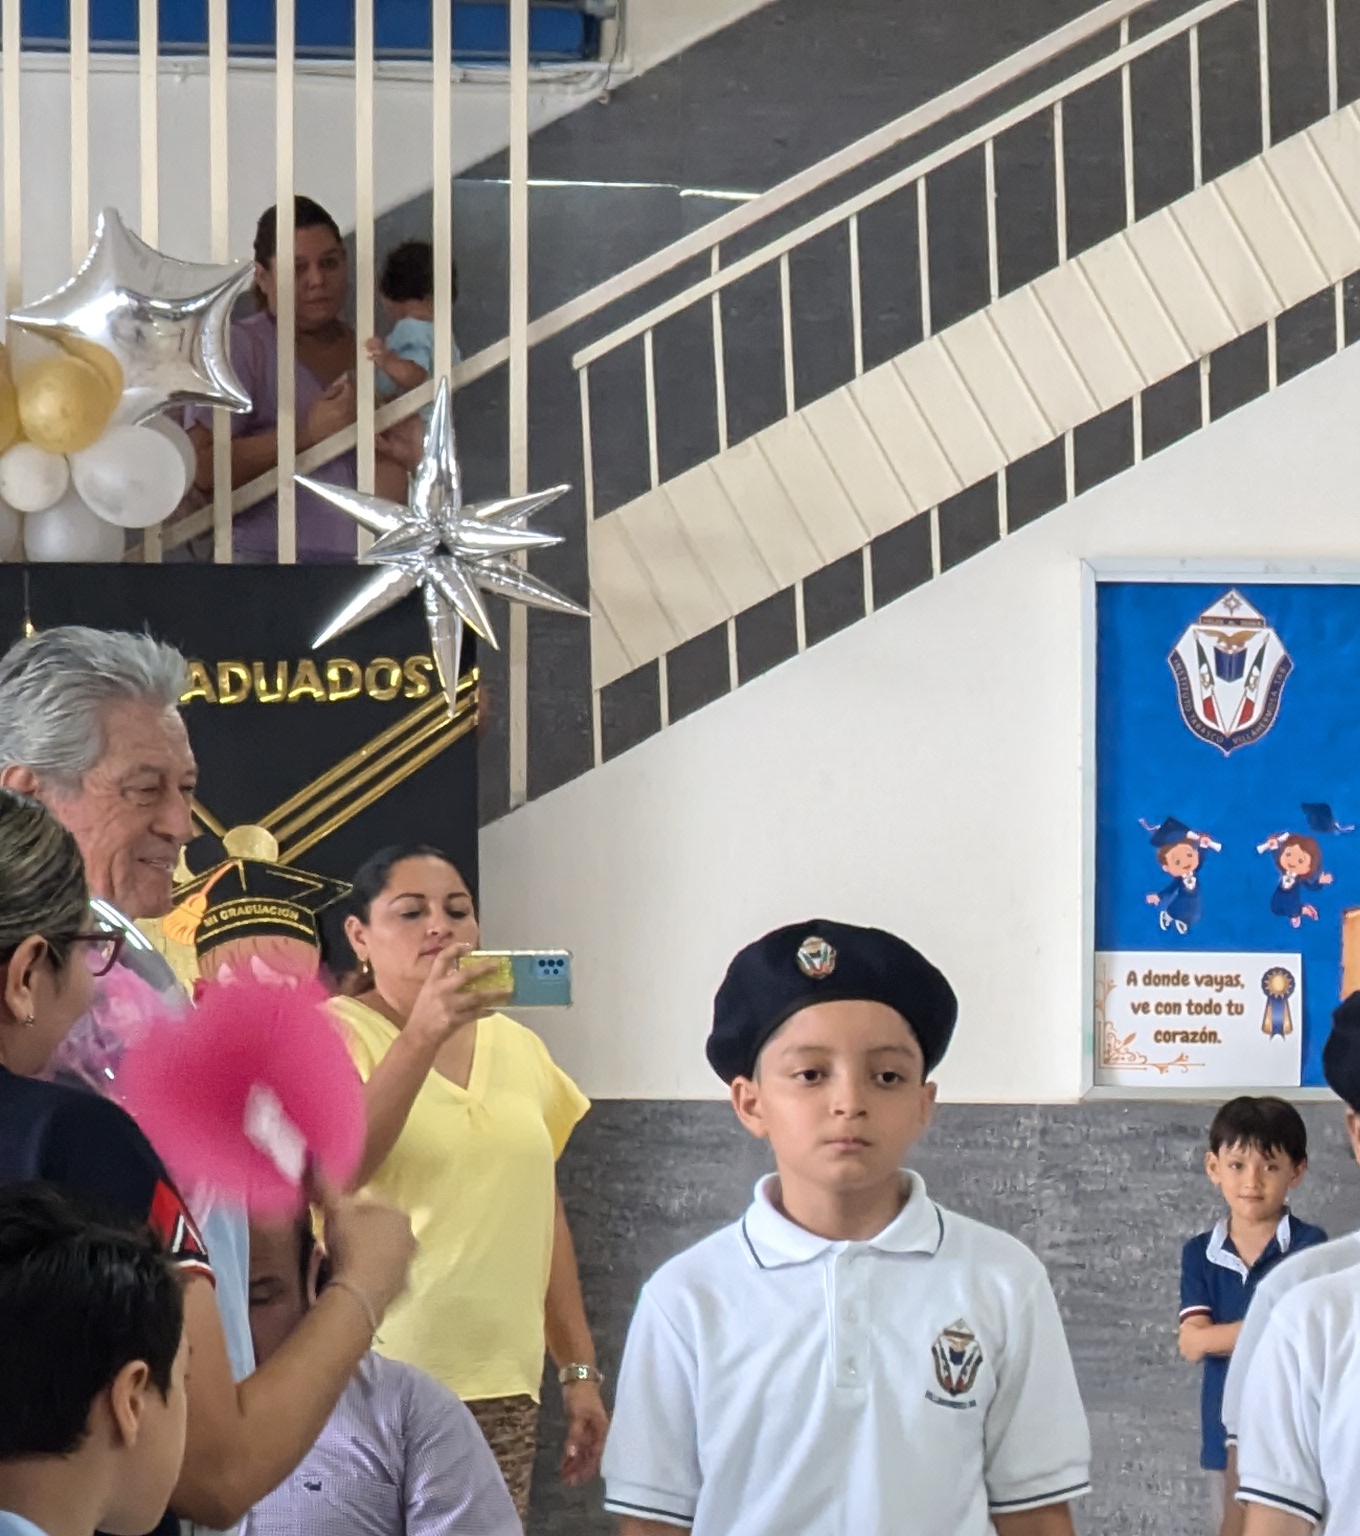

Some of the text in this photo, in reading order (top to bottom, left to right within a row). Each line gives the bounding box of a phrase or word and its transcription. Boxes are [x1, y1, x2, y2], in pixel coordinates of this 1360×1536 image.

[180, 655, 434, 703] ADUADOS
[203, 914, 219, 928] MI
[1126, 969, 1245, 993] A donde vayas,
[1131, 998, 1244, 1016] ve con todo tu
[1153, 1026, 1222, 1044] corazón.
